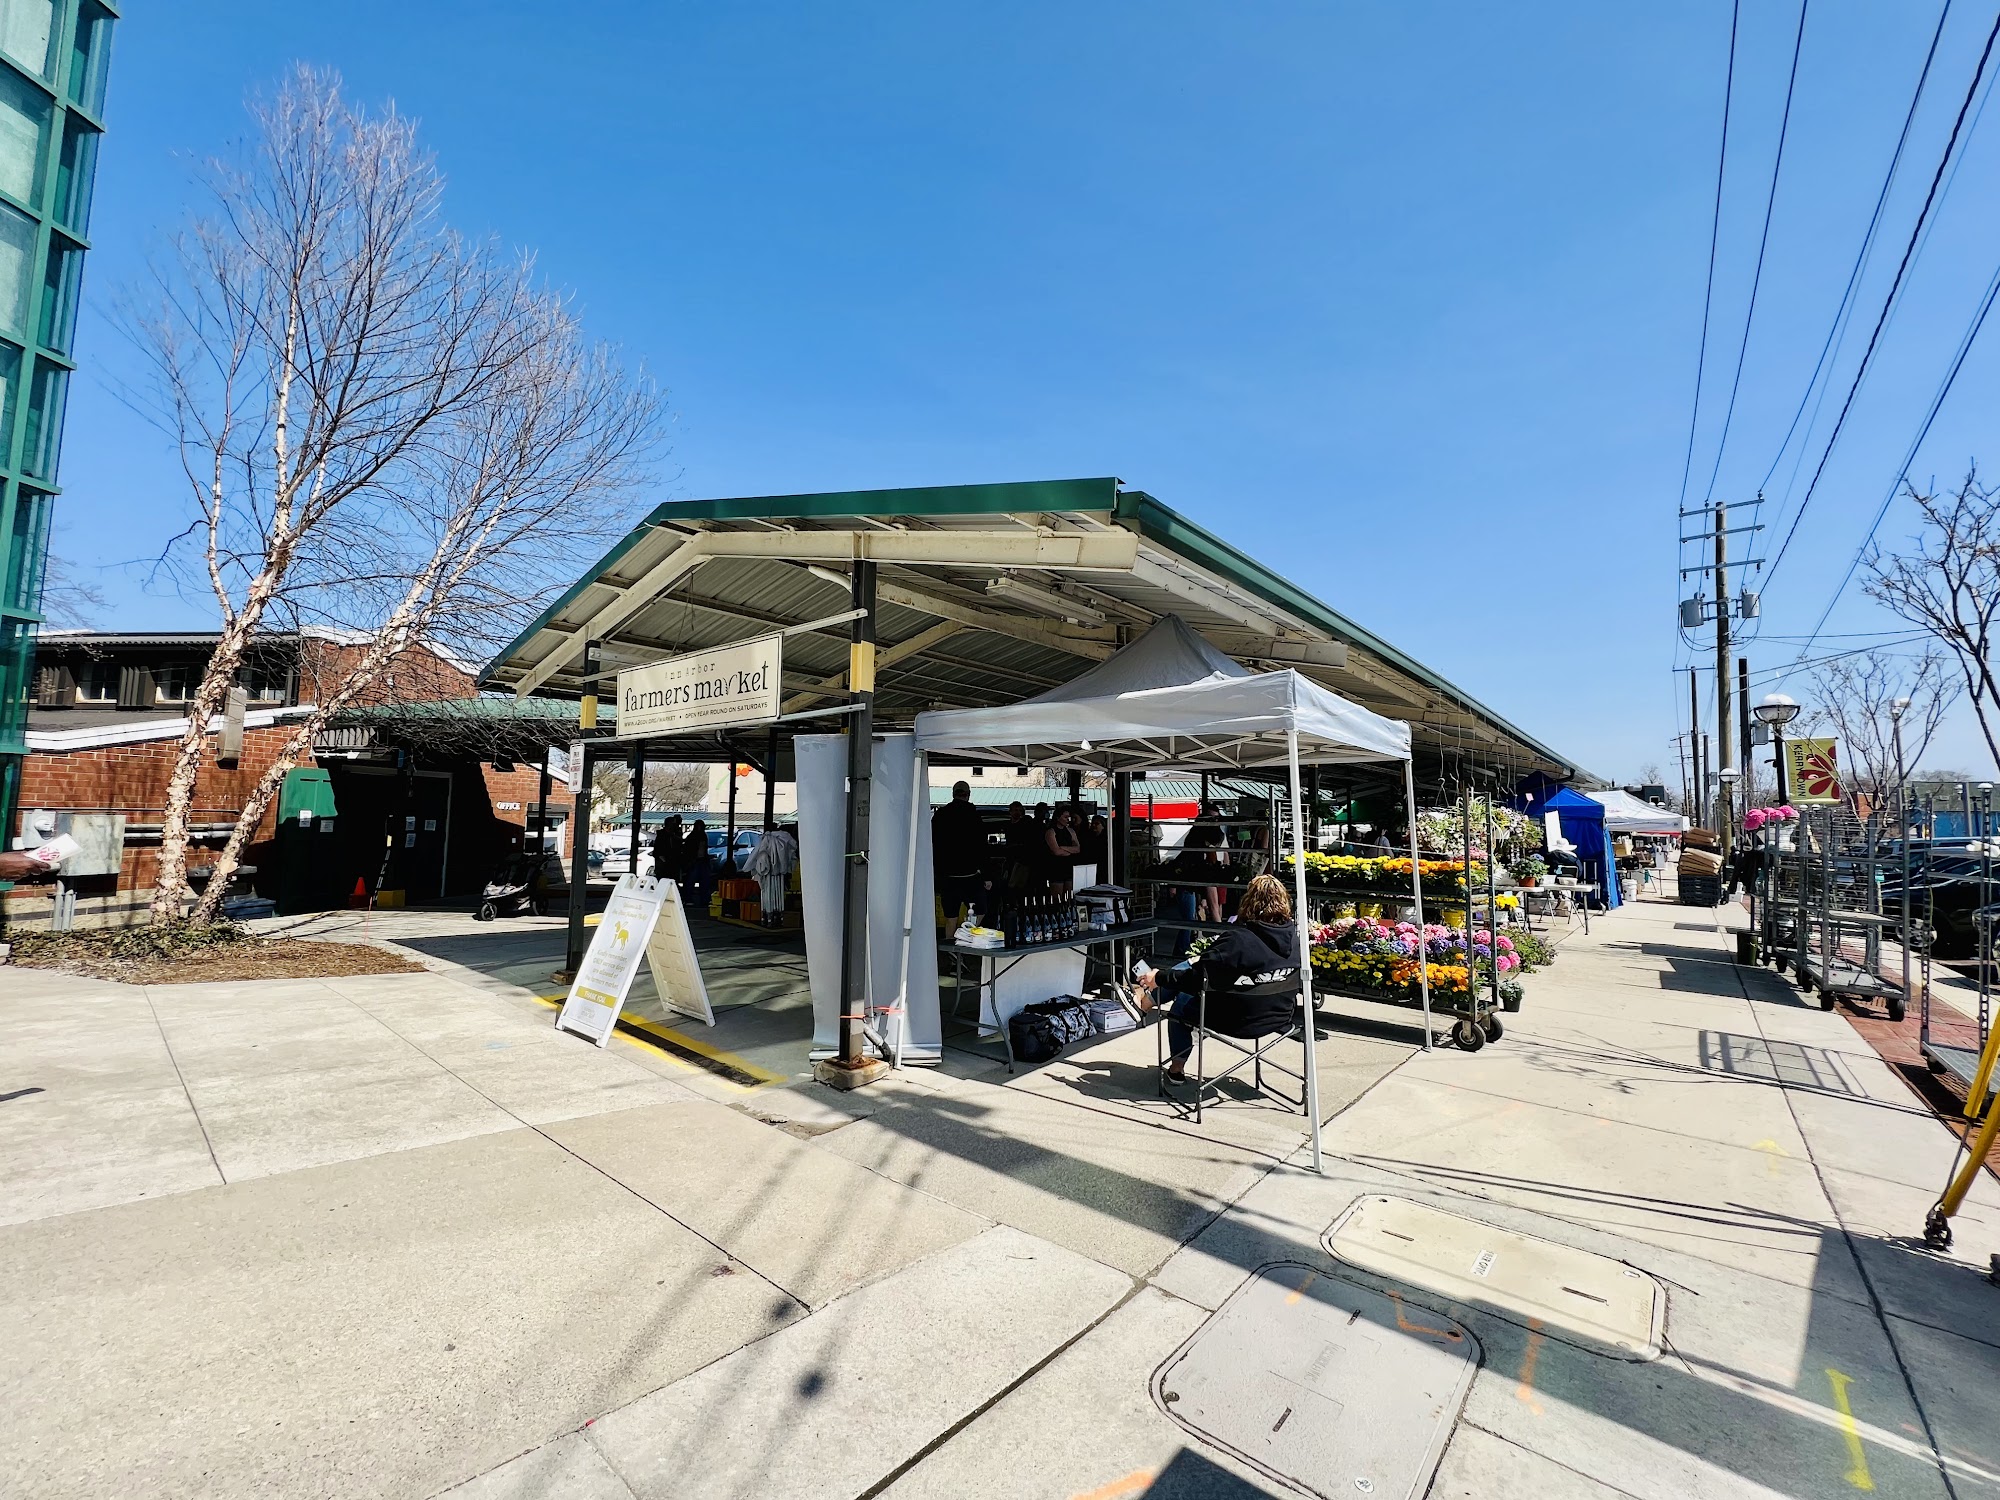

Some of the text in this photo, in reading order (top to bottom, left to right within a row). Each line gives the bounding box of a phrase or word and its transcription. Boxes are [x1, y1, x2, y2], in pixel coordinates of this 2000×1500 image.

[685, 662, 716, 676] Arbor
[624, 660, 769, 712] farmers market
[697, 710, 709, 718] YEAR
[710, 707, 728, 716] ROUND
[737, 701, 768, 712] SATURDAYS
[1794, 744, 1806, 797] KERRYTOWN
[496, 802, 521, 811] OFFICE
